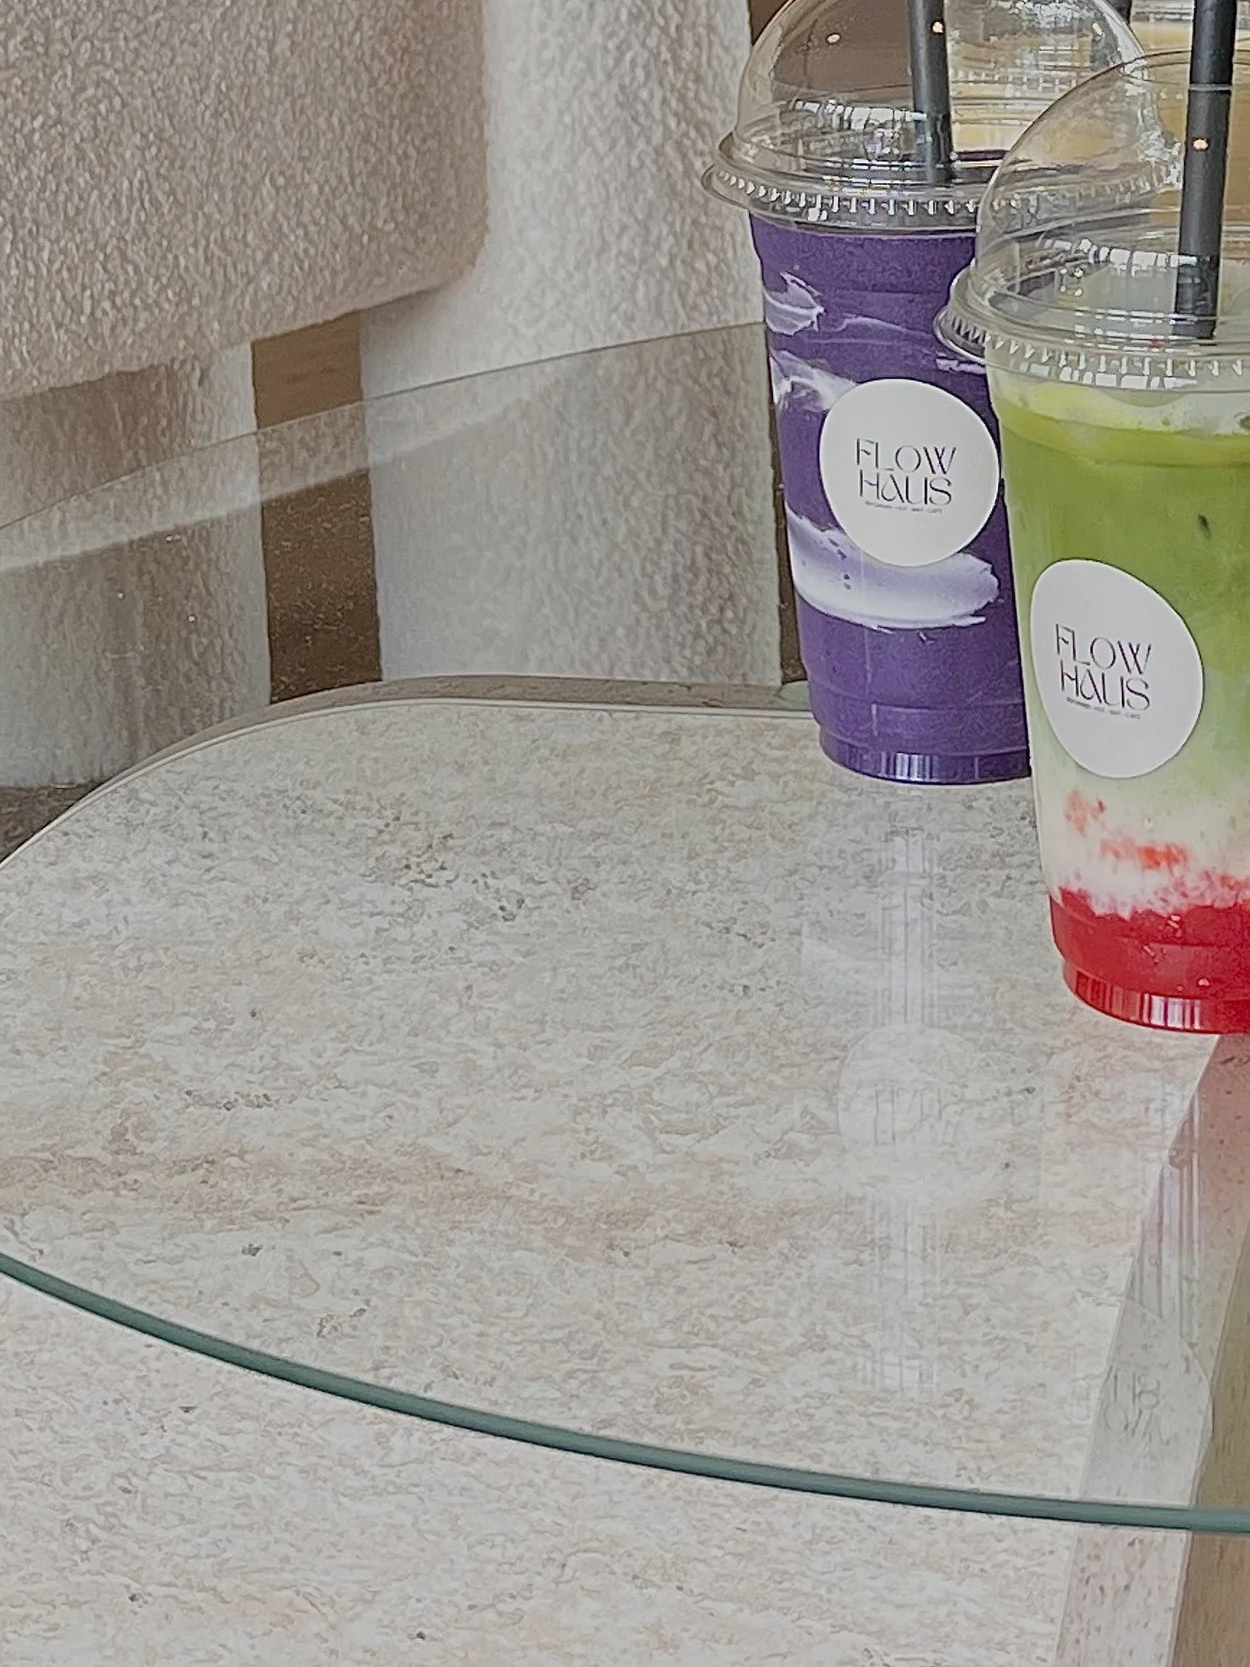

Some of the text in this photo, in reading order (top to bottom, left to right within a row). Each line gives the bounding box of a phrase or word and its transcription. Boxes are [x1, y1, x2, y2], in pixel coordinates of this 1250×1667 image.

[856, 437, 957, 475] FLOW
[859, 468, 952, 506] HAUS
[1055, 623, 1152, 675] FLOW
[1060, 659, 1151, 712] HAUS
